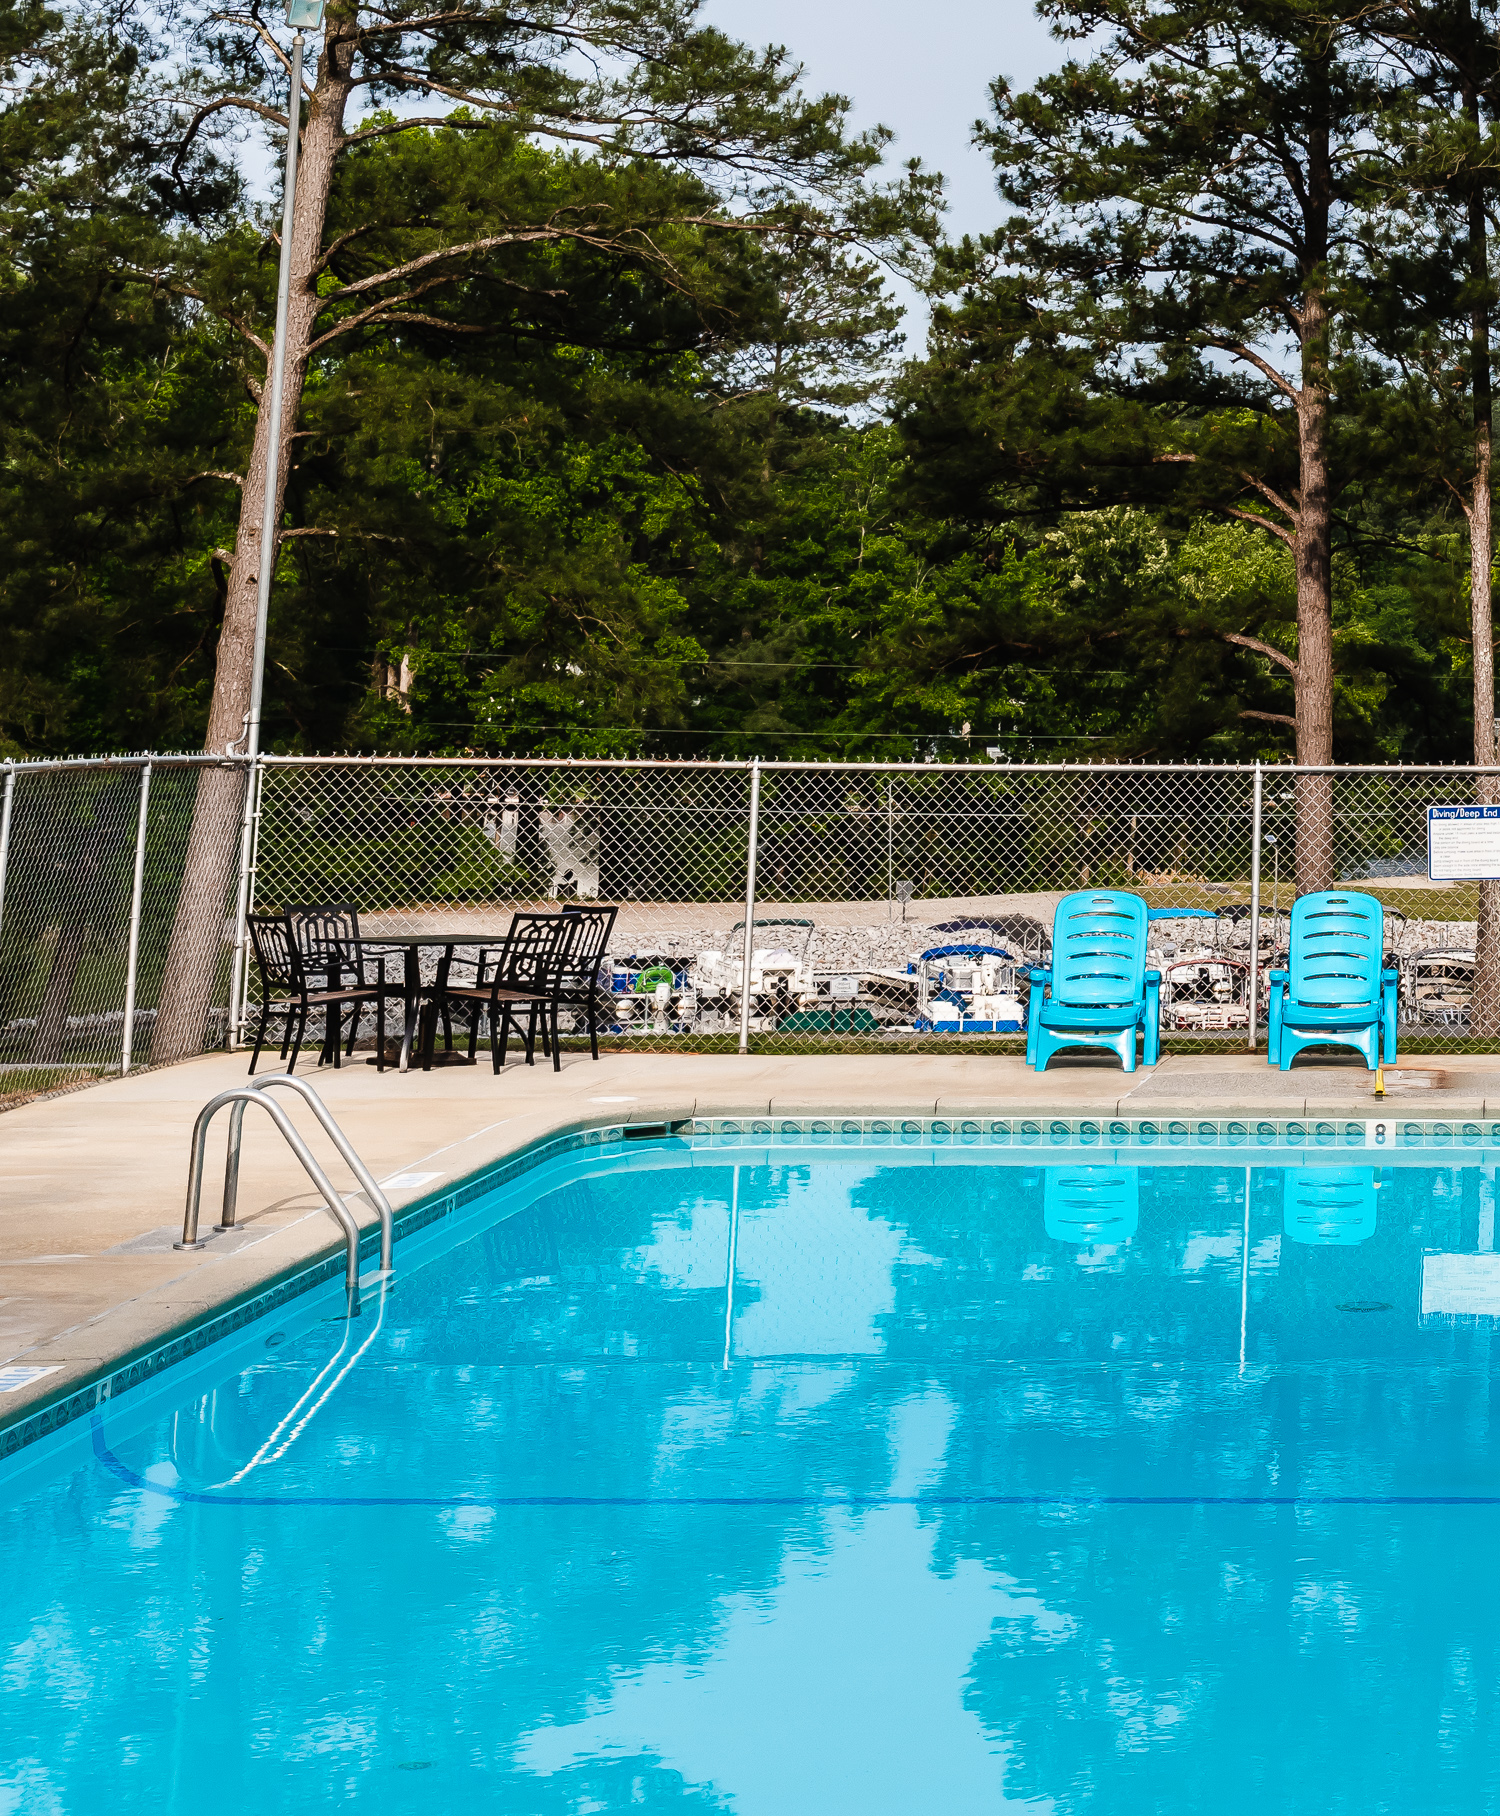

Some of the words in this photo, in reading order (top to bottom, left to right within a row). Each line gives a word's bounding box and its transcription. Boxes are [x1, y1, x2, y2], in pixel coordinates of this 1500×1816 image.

[1432, 807, 1480, 819] Diving/Deep
[1483, 807, 1498, 817] End
[1375, 1123, 1386, 1145] 8
